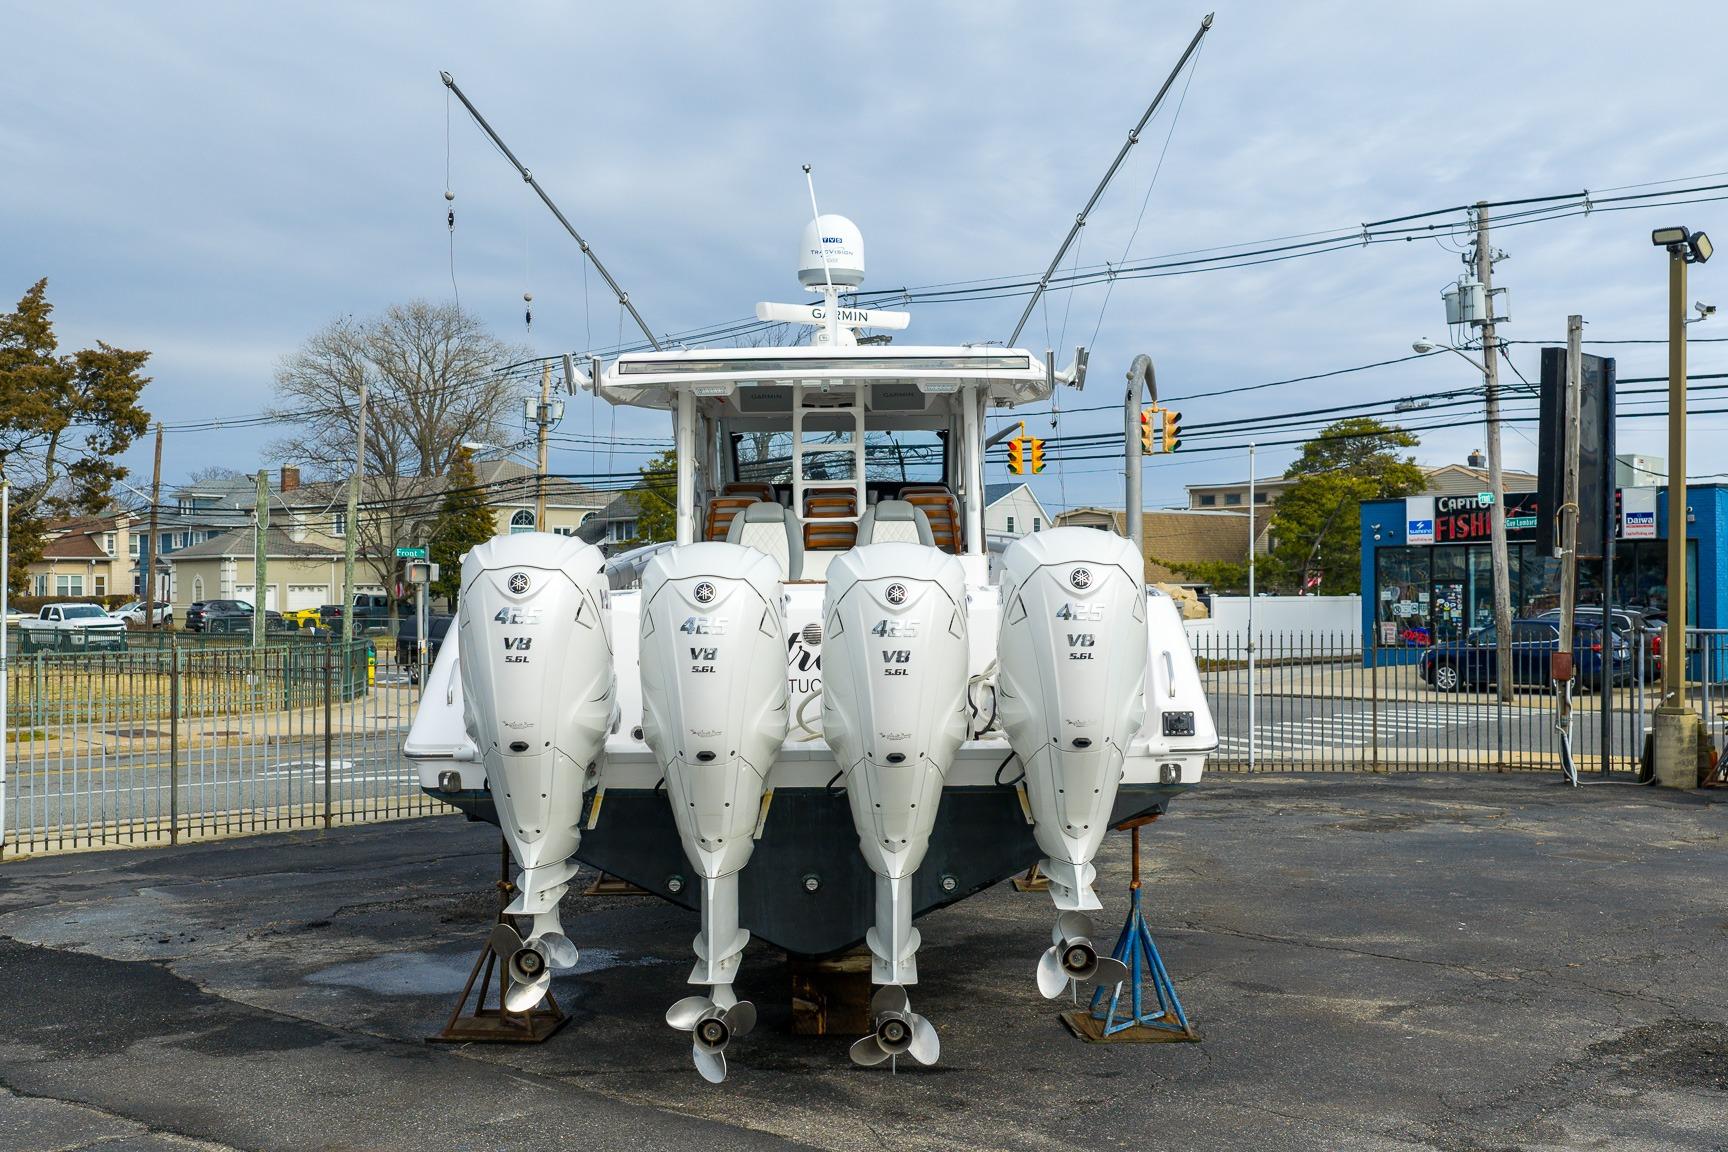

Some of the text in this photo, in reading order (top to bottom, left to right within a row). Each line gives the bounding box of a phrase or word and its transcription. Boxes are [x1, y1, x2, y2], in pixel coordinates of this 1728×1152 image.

[396, 548, 417, 557] Front
[1056, 602, 1105, 621] 425
[680, 616, 729, 635] 425
[872, 619, 920, 638] 425
[503, 637, 532, 650] V8
[1067, 633, 1095, 647] V8
[505, 655, 530, 663] 5.6L
[690, 647, 718, 660] V8
[882, 650, 911, 663] V8
[1069, 652, 1094, 660] 5.6L
[691, 665, 716, 673] 5.6L
[884, 668, 909, 676] 5.6L
